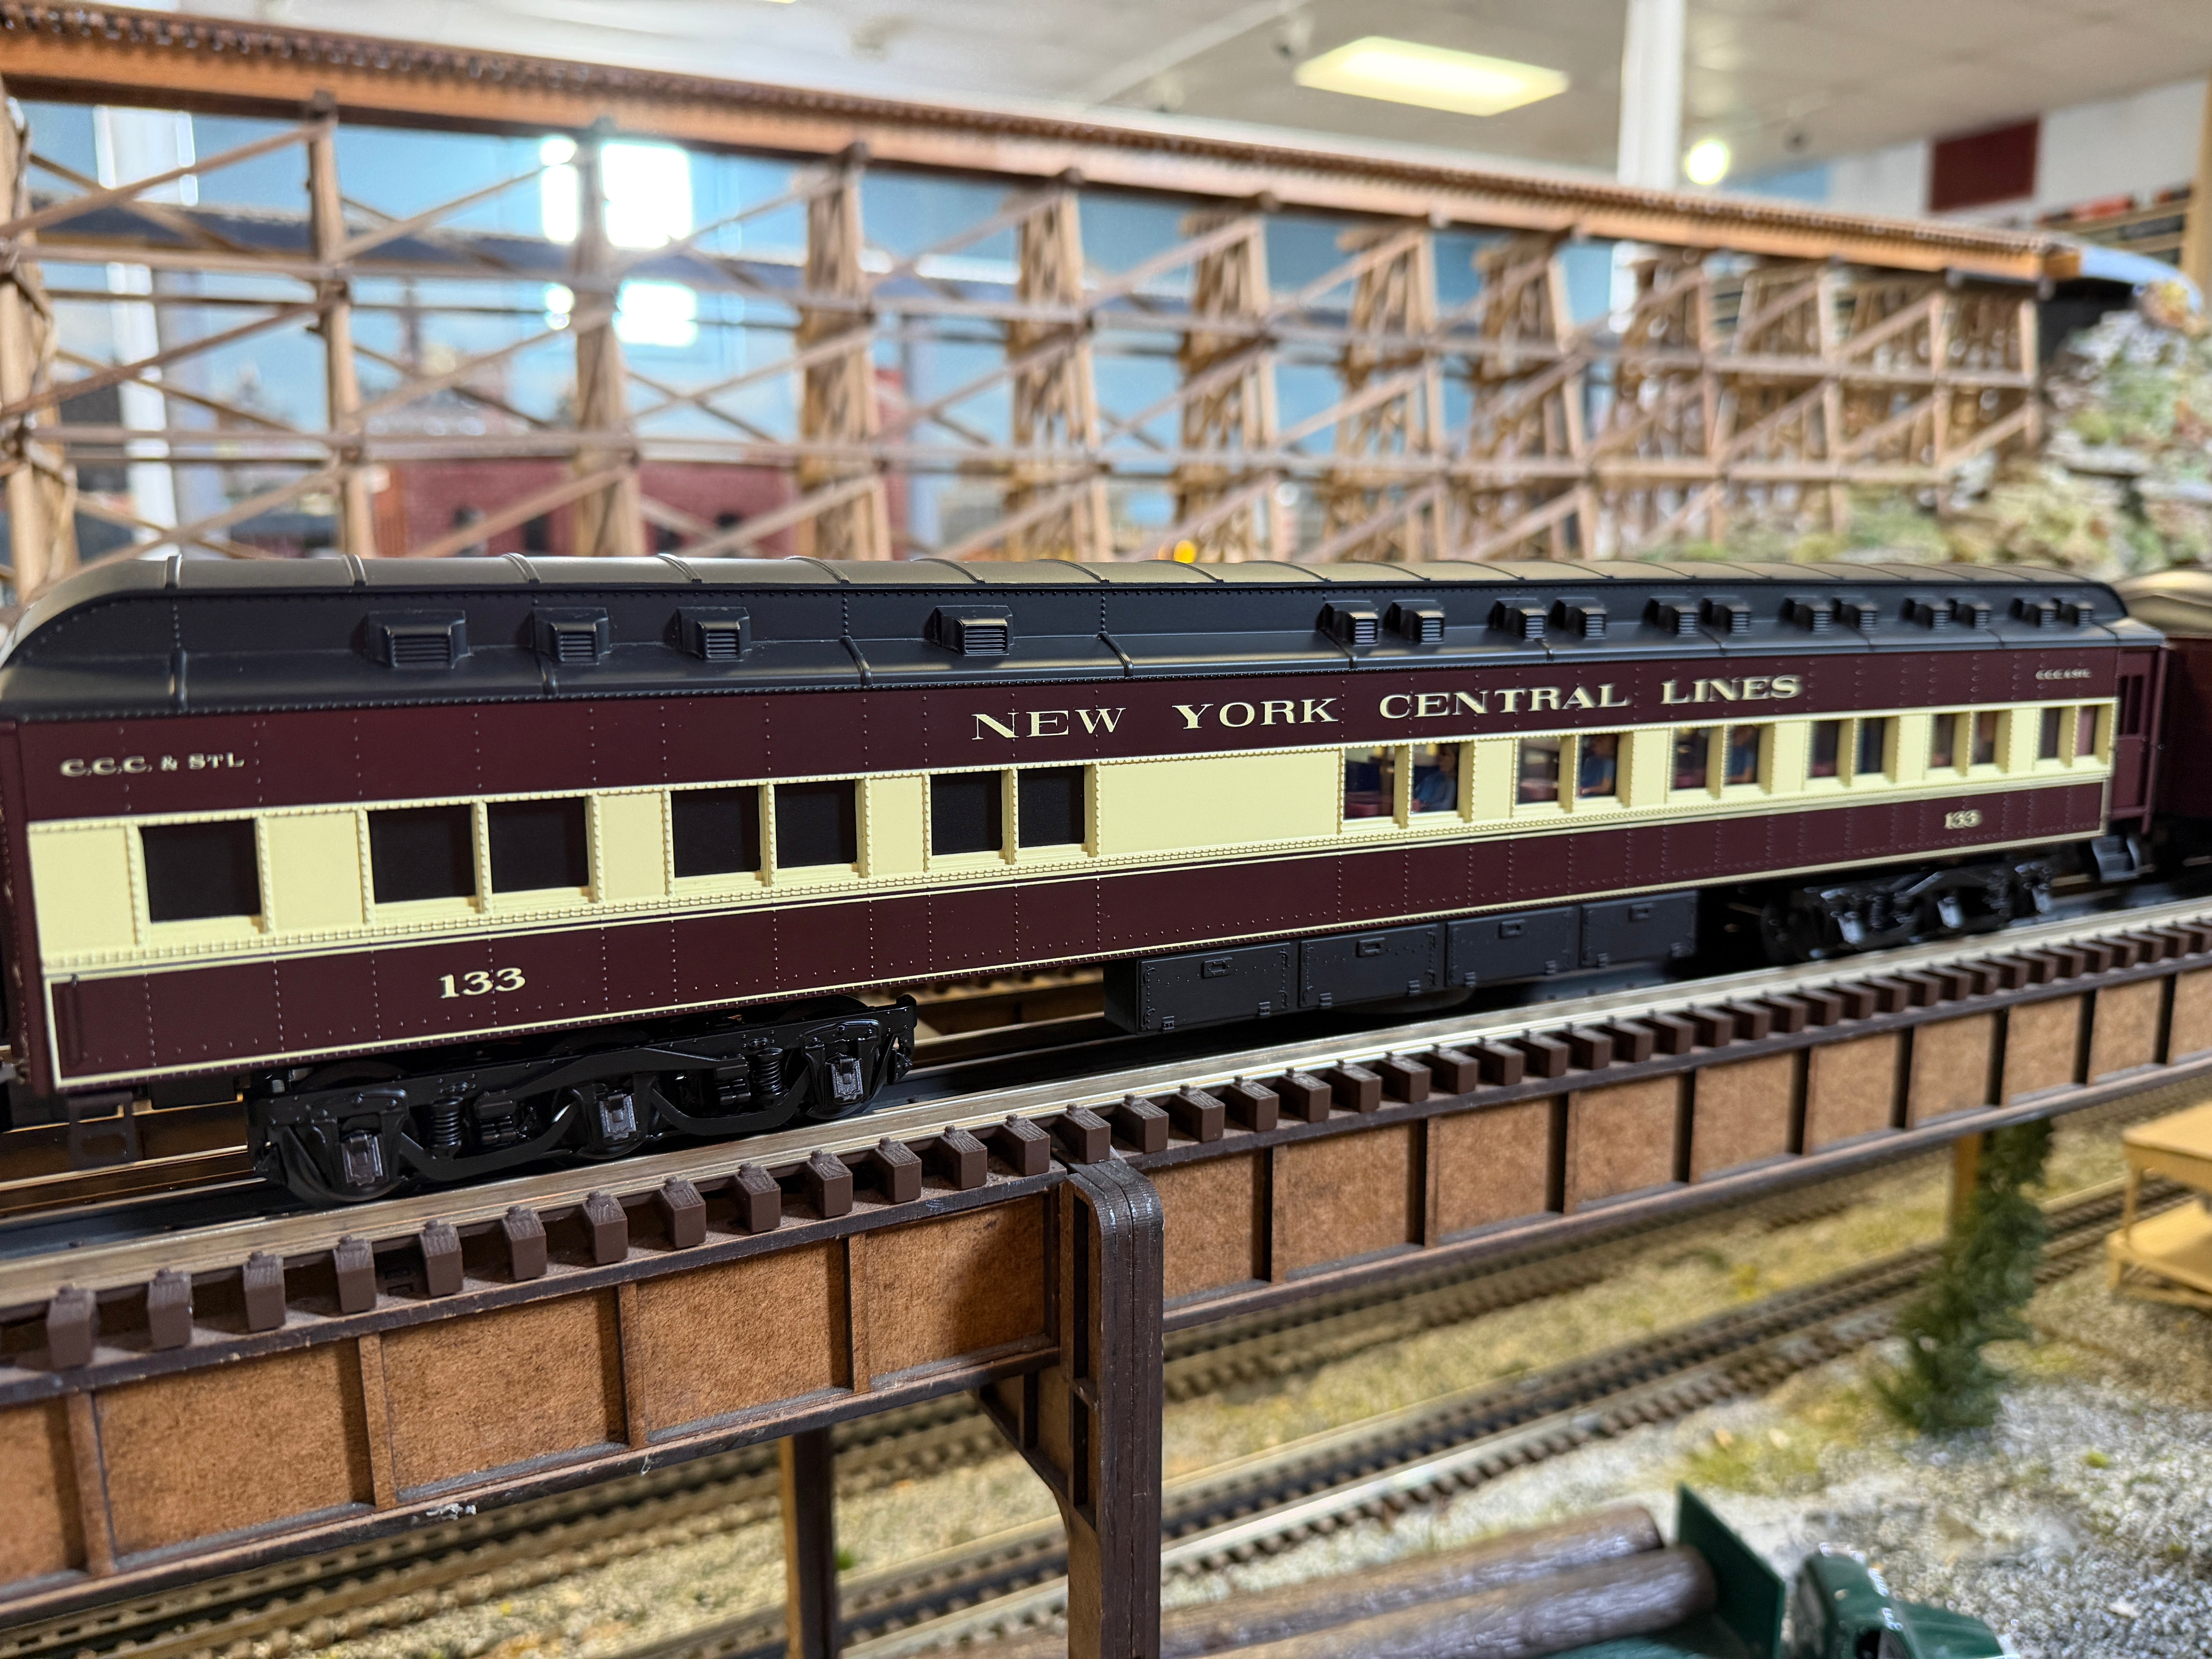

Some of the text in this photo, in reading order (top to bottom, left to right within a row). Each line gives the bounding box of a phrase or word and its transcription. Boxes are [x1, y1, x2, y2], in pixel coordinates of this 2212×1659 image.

[972, 675, 1802, 740] NEW YORK CENTRAL LINES
[161, 756, 178, 771] &
[1944, 809, 1982, 830] 133
[439, 967, 526, 999] 133
